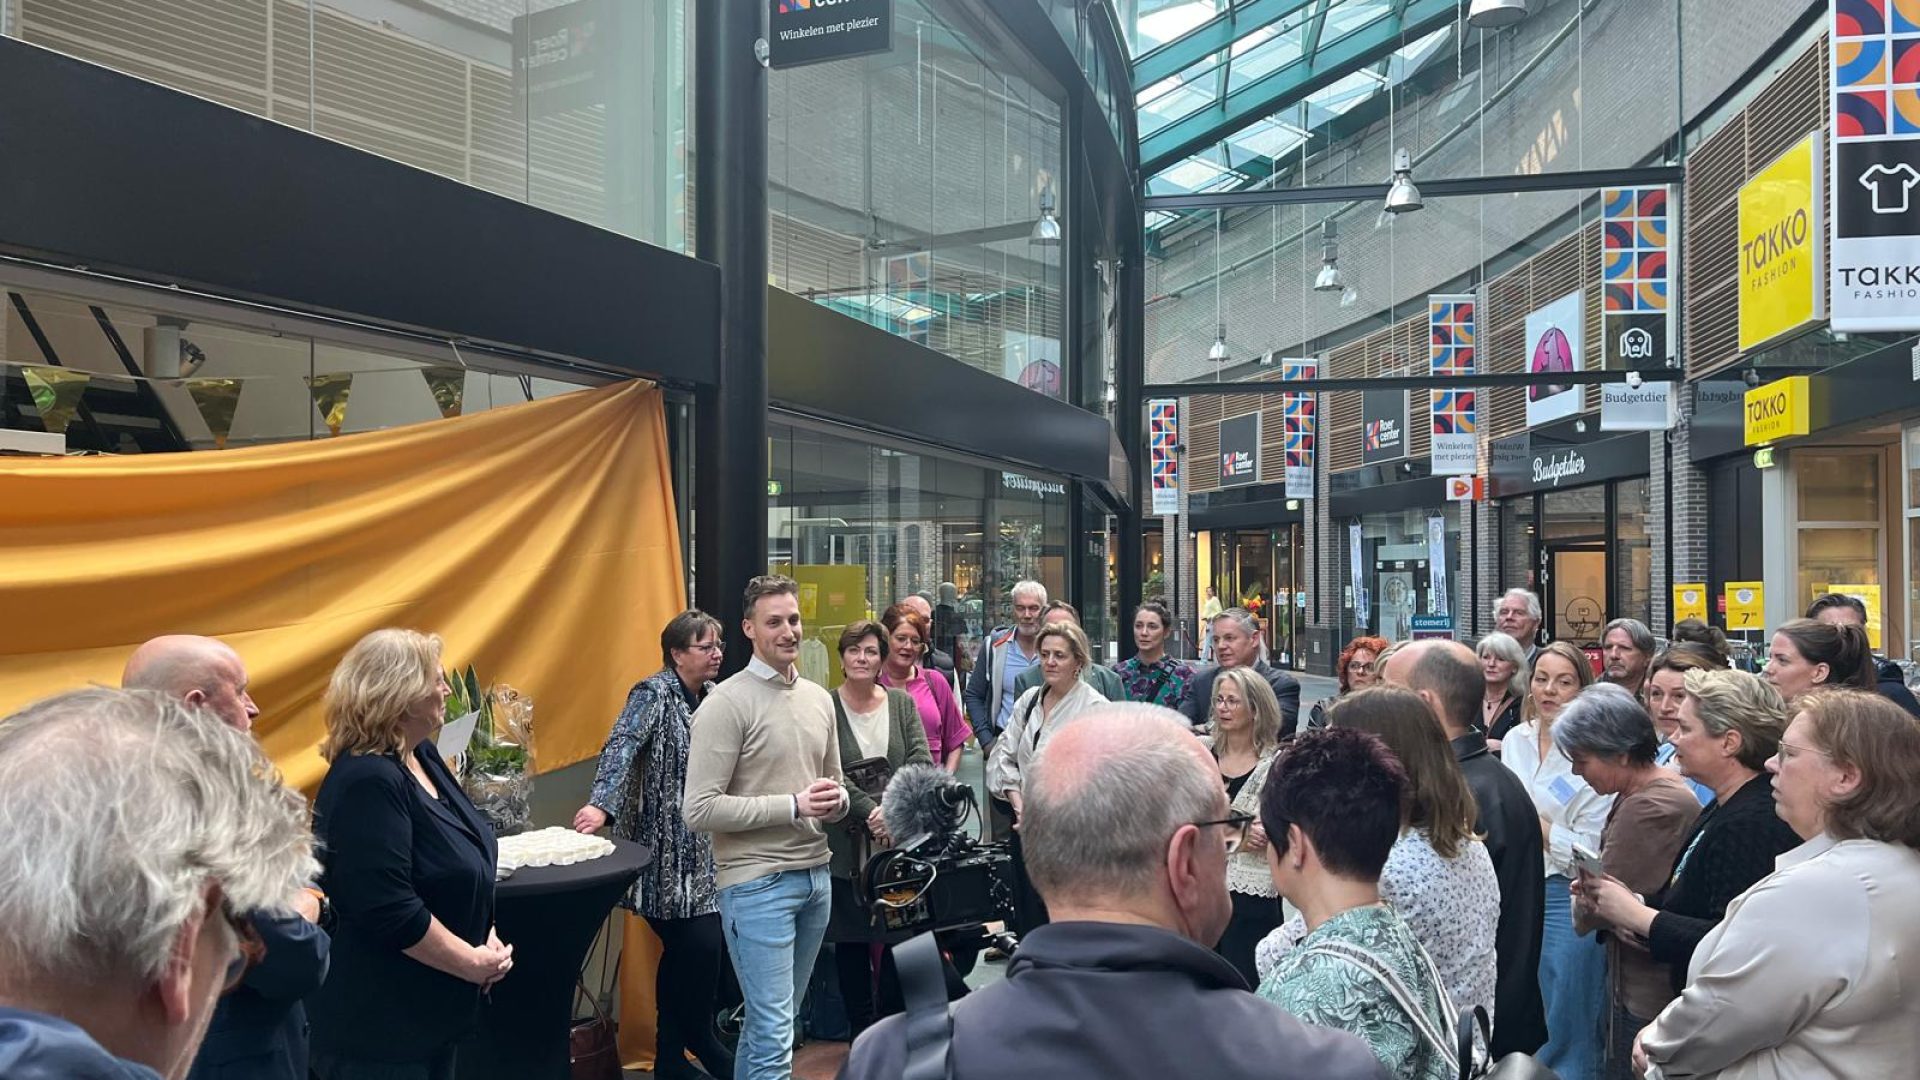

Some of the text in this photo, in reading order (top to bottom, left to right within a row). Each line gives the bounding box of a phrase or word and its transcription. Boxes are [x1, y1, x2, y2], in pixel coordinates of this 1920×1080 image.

[780, 17, 879, 40] Winkelen met plezier
[1751, 257, 1797, 292] FASHION
[1838, 265, 1920, 287] TaKK
[1854, 289, 1920, 300] FASHIO
[1605, 391, 1667, 405] Budgetdier
[1752, 421, 1780, 434] FASHION
[1436, 442, 1473, 451] Winkelen
[1434, 452, 1476, 462] met plezier
[1532, 450, 1586, 486] Budgetdier
[1414, 618, 1450, 628] stomerij
